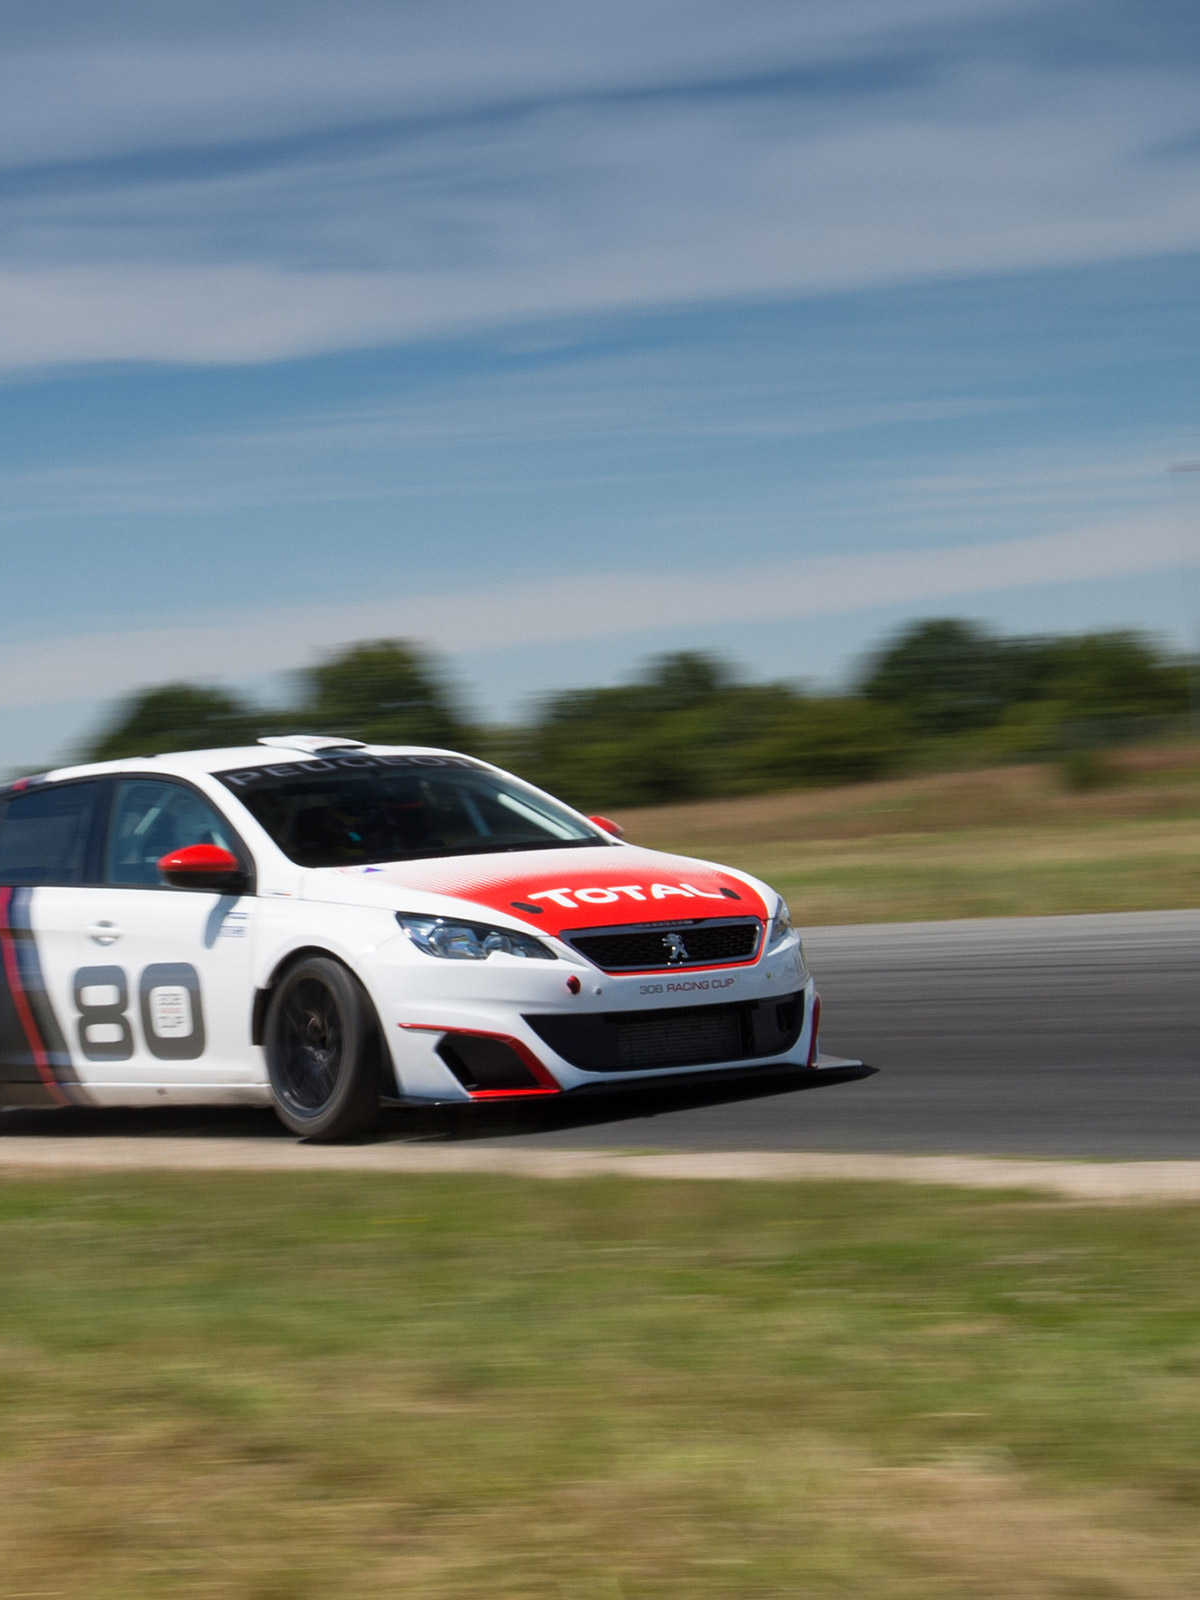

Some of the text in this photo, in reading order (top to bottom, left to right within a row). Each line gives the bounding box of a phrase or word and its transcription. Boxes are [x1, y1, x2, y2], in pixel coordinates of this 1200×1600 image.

[224, 755, 473, 786] PEUGEOT
[527, 883, 726, 908] TOTAL
[639, 978, 735, 995] 308 RACING CUP
[73, 962, 205, 1062] 80
